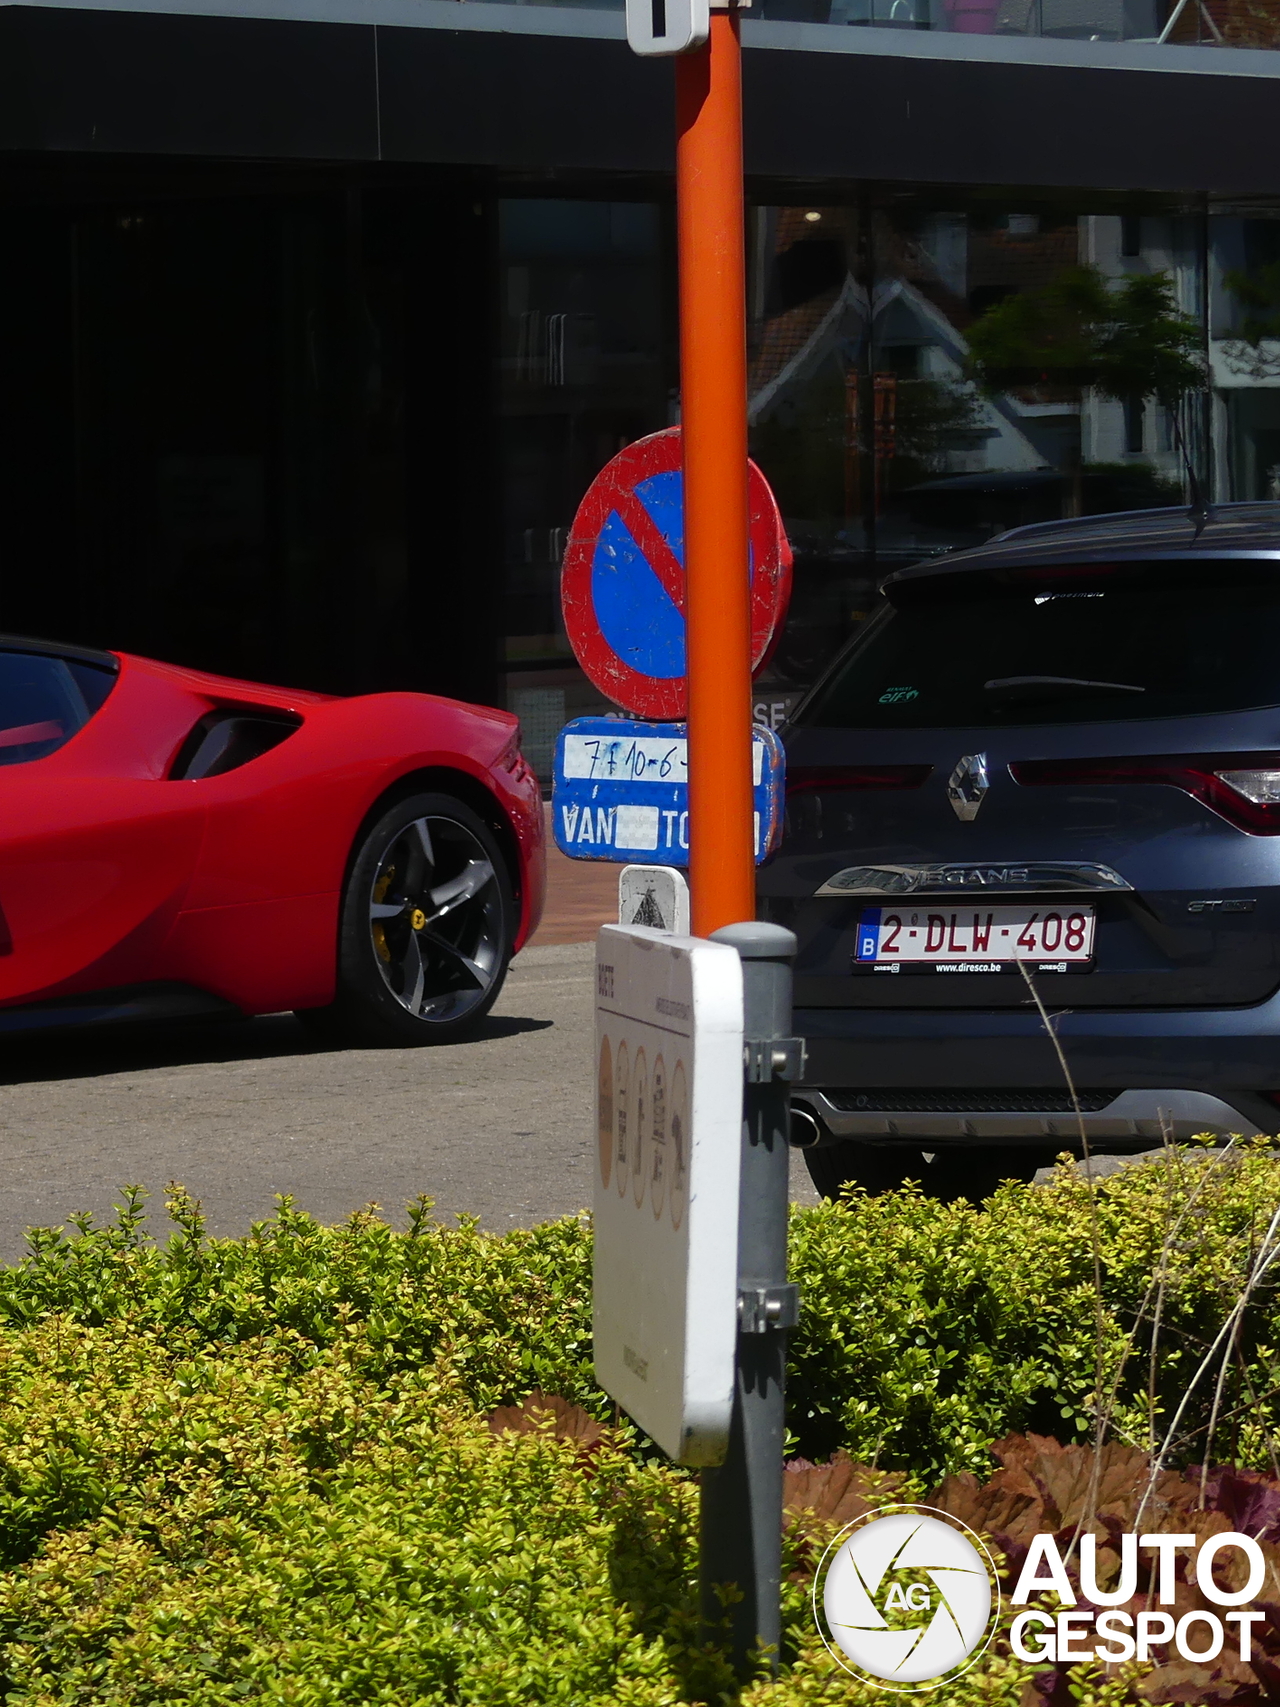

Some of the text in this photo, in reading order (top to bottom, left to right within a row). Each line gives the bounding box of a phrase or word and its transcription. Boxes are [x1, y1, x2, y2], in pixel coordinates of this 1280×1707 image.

[562, 805, 689, 849] VAN TO
[862, 912, 1087, 956] B 2-DLW-408
[935, 963, 1002, 973] www.diresco.be
